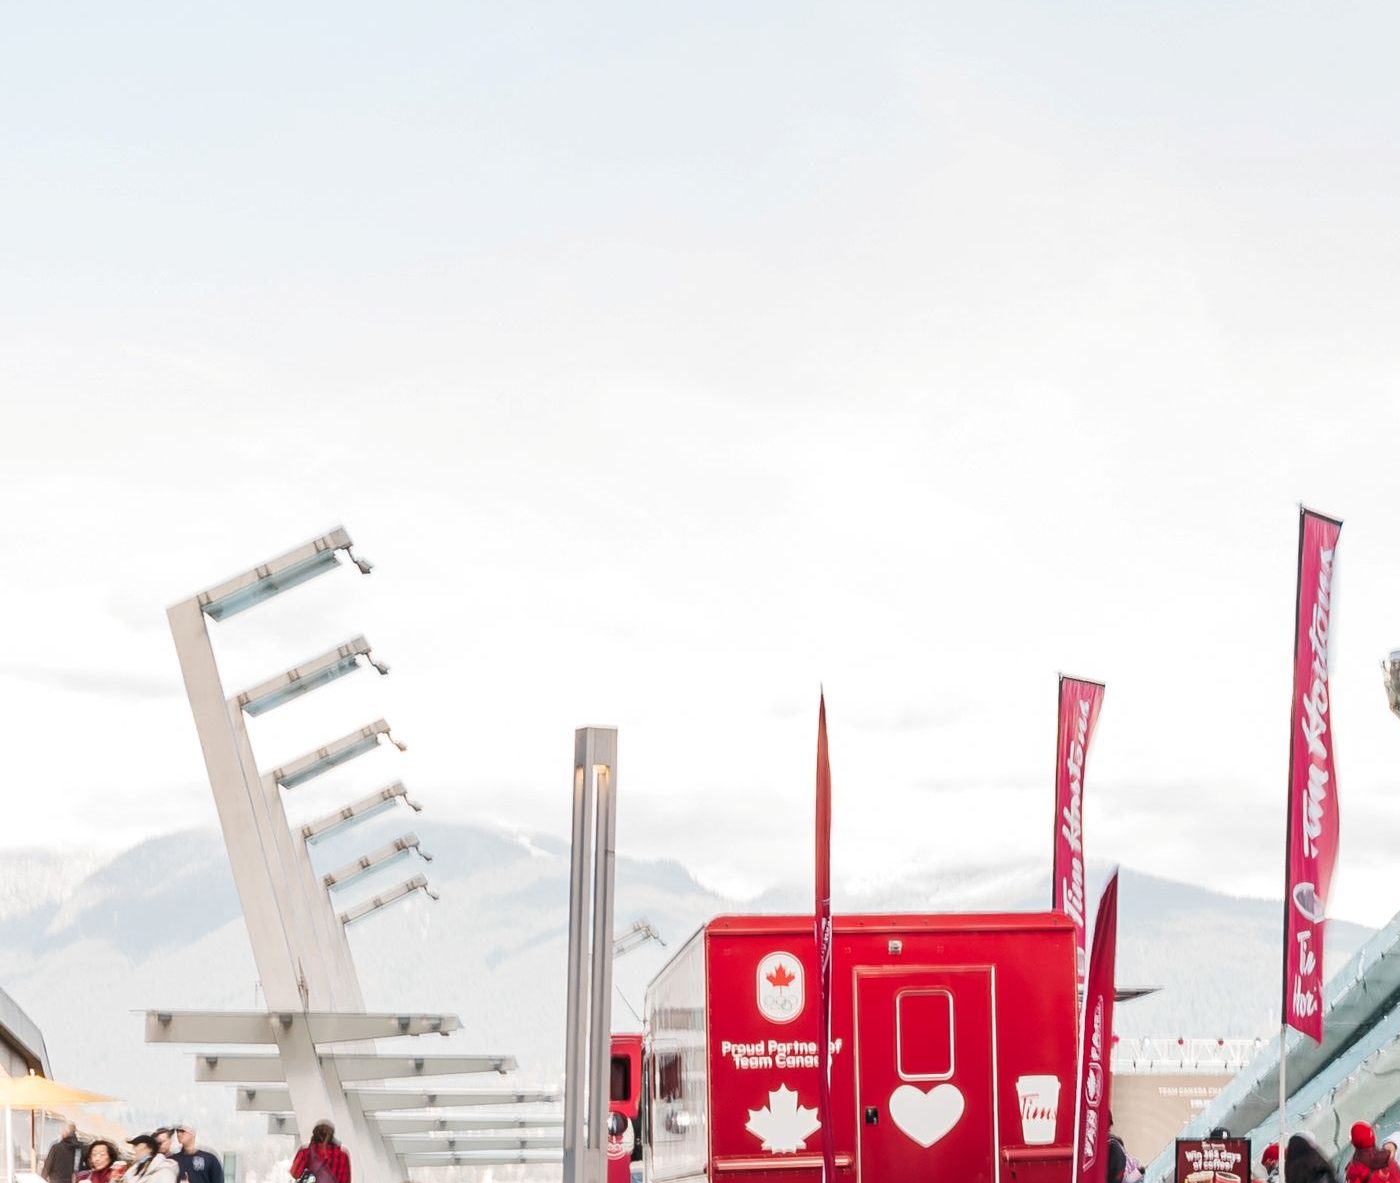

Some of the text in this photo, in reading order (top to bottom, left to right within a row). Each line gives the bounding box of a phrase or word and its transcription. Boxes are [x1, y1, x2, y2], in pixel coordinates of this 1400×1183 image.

[721, 1039, 765, 1058] Proud
[767, 1039, 818, 1055] Partne
[734, 1052, 820, 1070] Team Cana
[1021, 1093, 1057, 1120] Tims
